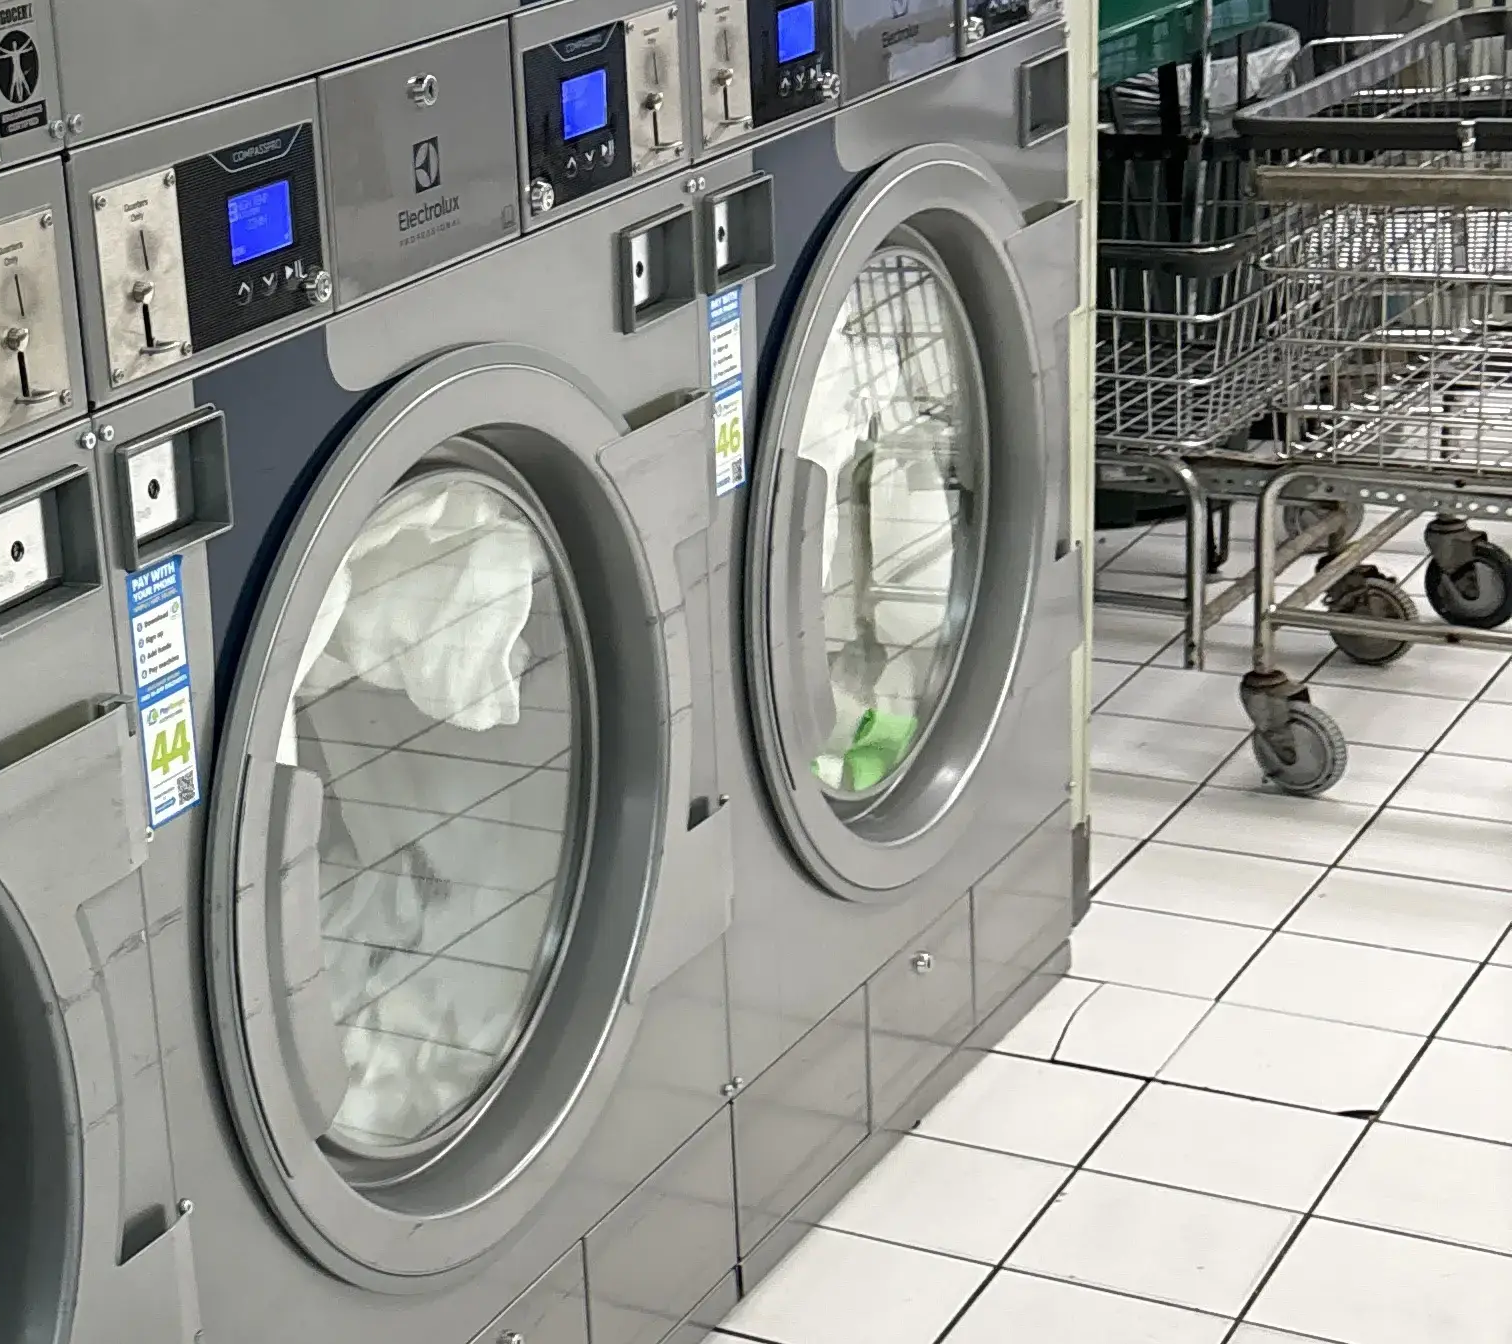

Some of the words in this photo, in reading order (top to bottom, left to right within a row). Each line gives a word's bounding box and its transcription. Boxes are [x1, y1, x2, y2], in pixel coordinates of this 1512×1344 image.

[398, 196, 460, 231] Electrolux
[716, 417, 741, 457] 46
[132, 574, 151, 592] PAY
[151, 561, 176, 582] WITH
[151, 719, 190, 775] 44
